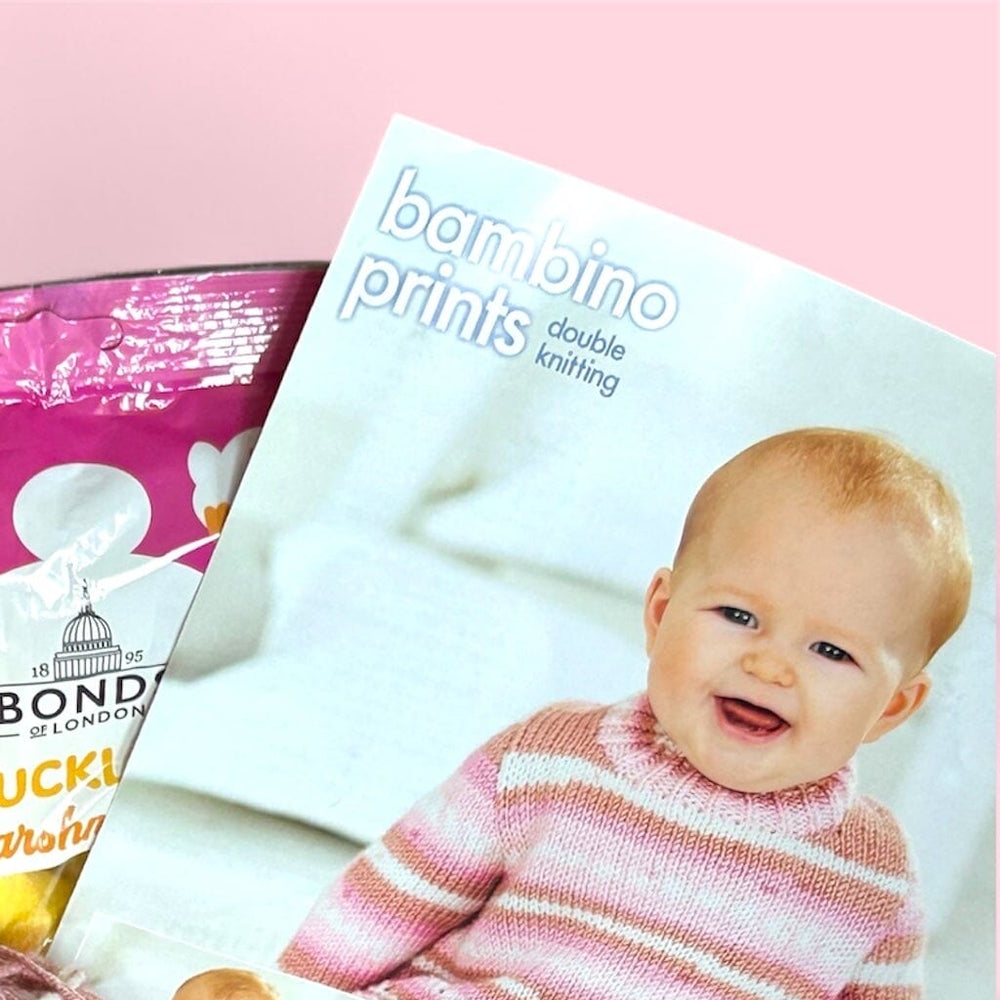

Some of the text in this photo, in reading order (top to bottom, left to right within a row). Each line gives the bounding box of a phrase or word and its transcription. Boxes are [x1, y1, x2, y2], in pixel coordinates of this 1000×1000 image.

[378, 166, 678, 331] bambino
[336, 254, 531, 359] prints
[548, 317, 626, 361] double
[534, 343, 621, 398] knitting
[31, 650, 144, 679] 18 95
[30, 704, 146, 737] OF LONDON
